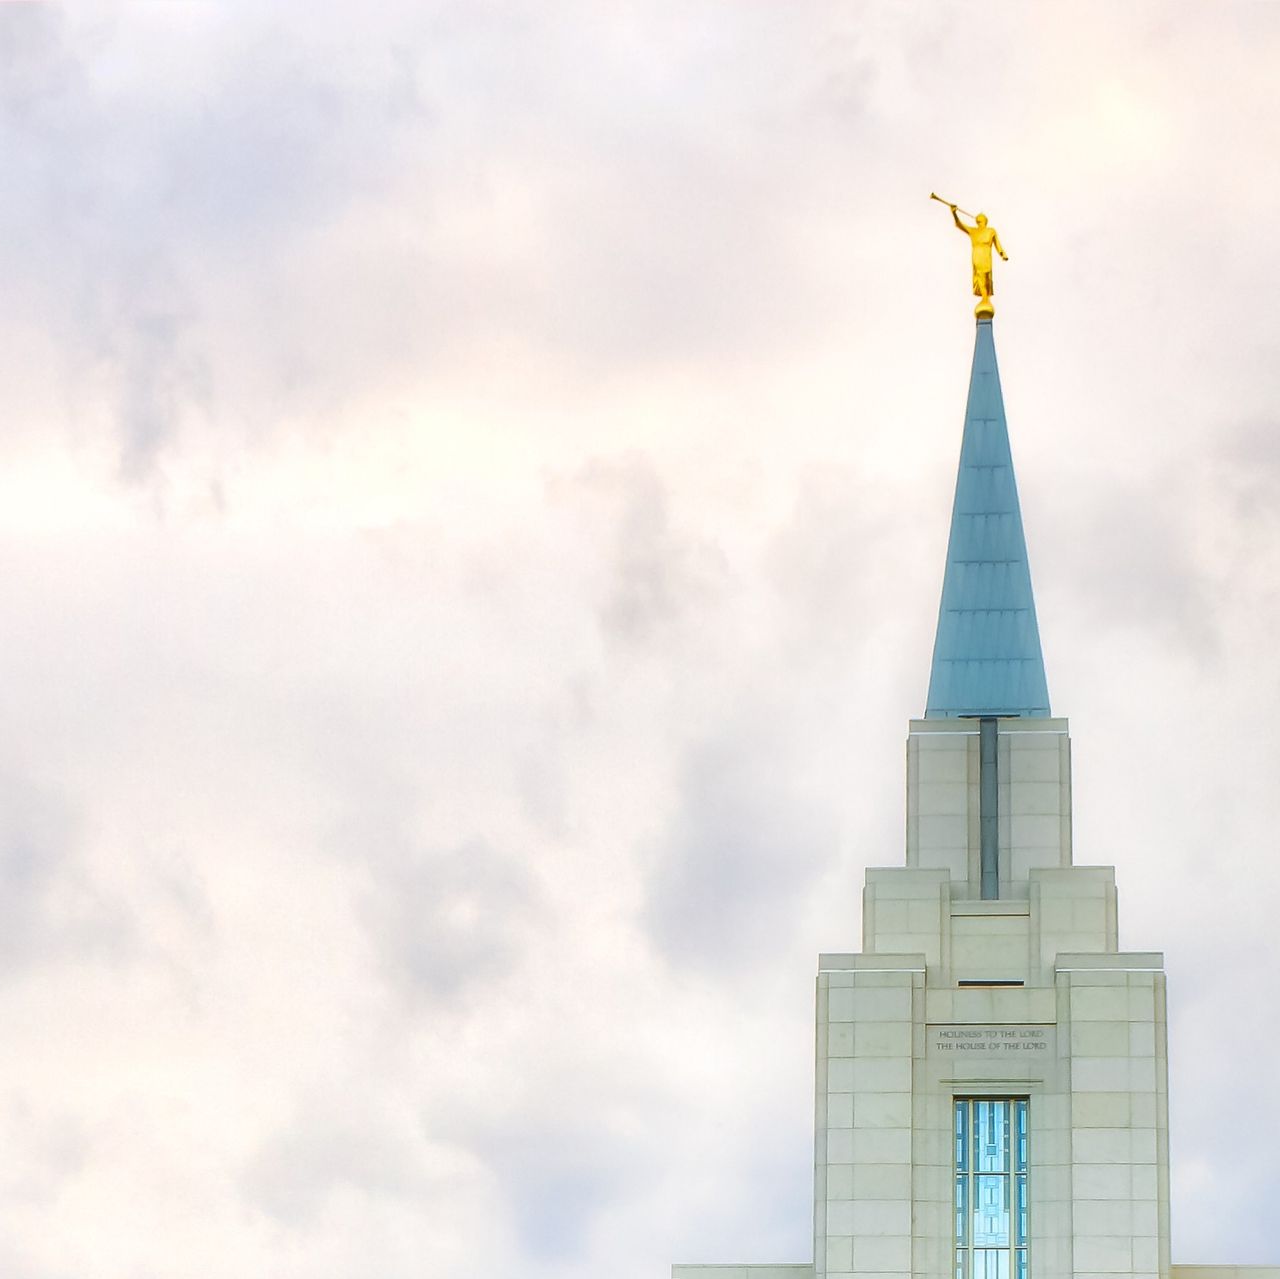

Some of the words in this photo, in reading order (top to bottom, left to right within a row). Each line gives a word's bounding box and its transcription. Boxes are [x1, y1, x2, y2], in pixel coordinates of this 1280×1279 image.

[984, 1030, 997, 1038] TO
[1000, 1030, 1017, 1038] THE
[1019, 1030, 1044, 1038] LORD
[936, 1042, 952, 1050] THE
[955, 1042, 986, 1050] HOUSE
[988, 1042, 1001, 1050] OF
[1003, 1042, 1020, 1050] THE
[1022, 1042, 1047, 1050] LORD
